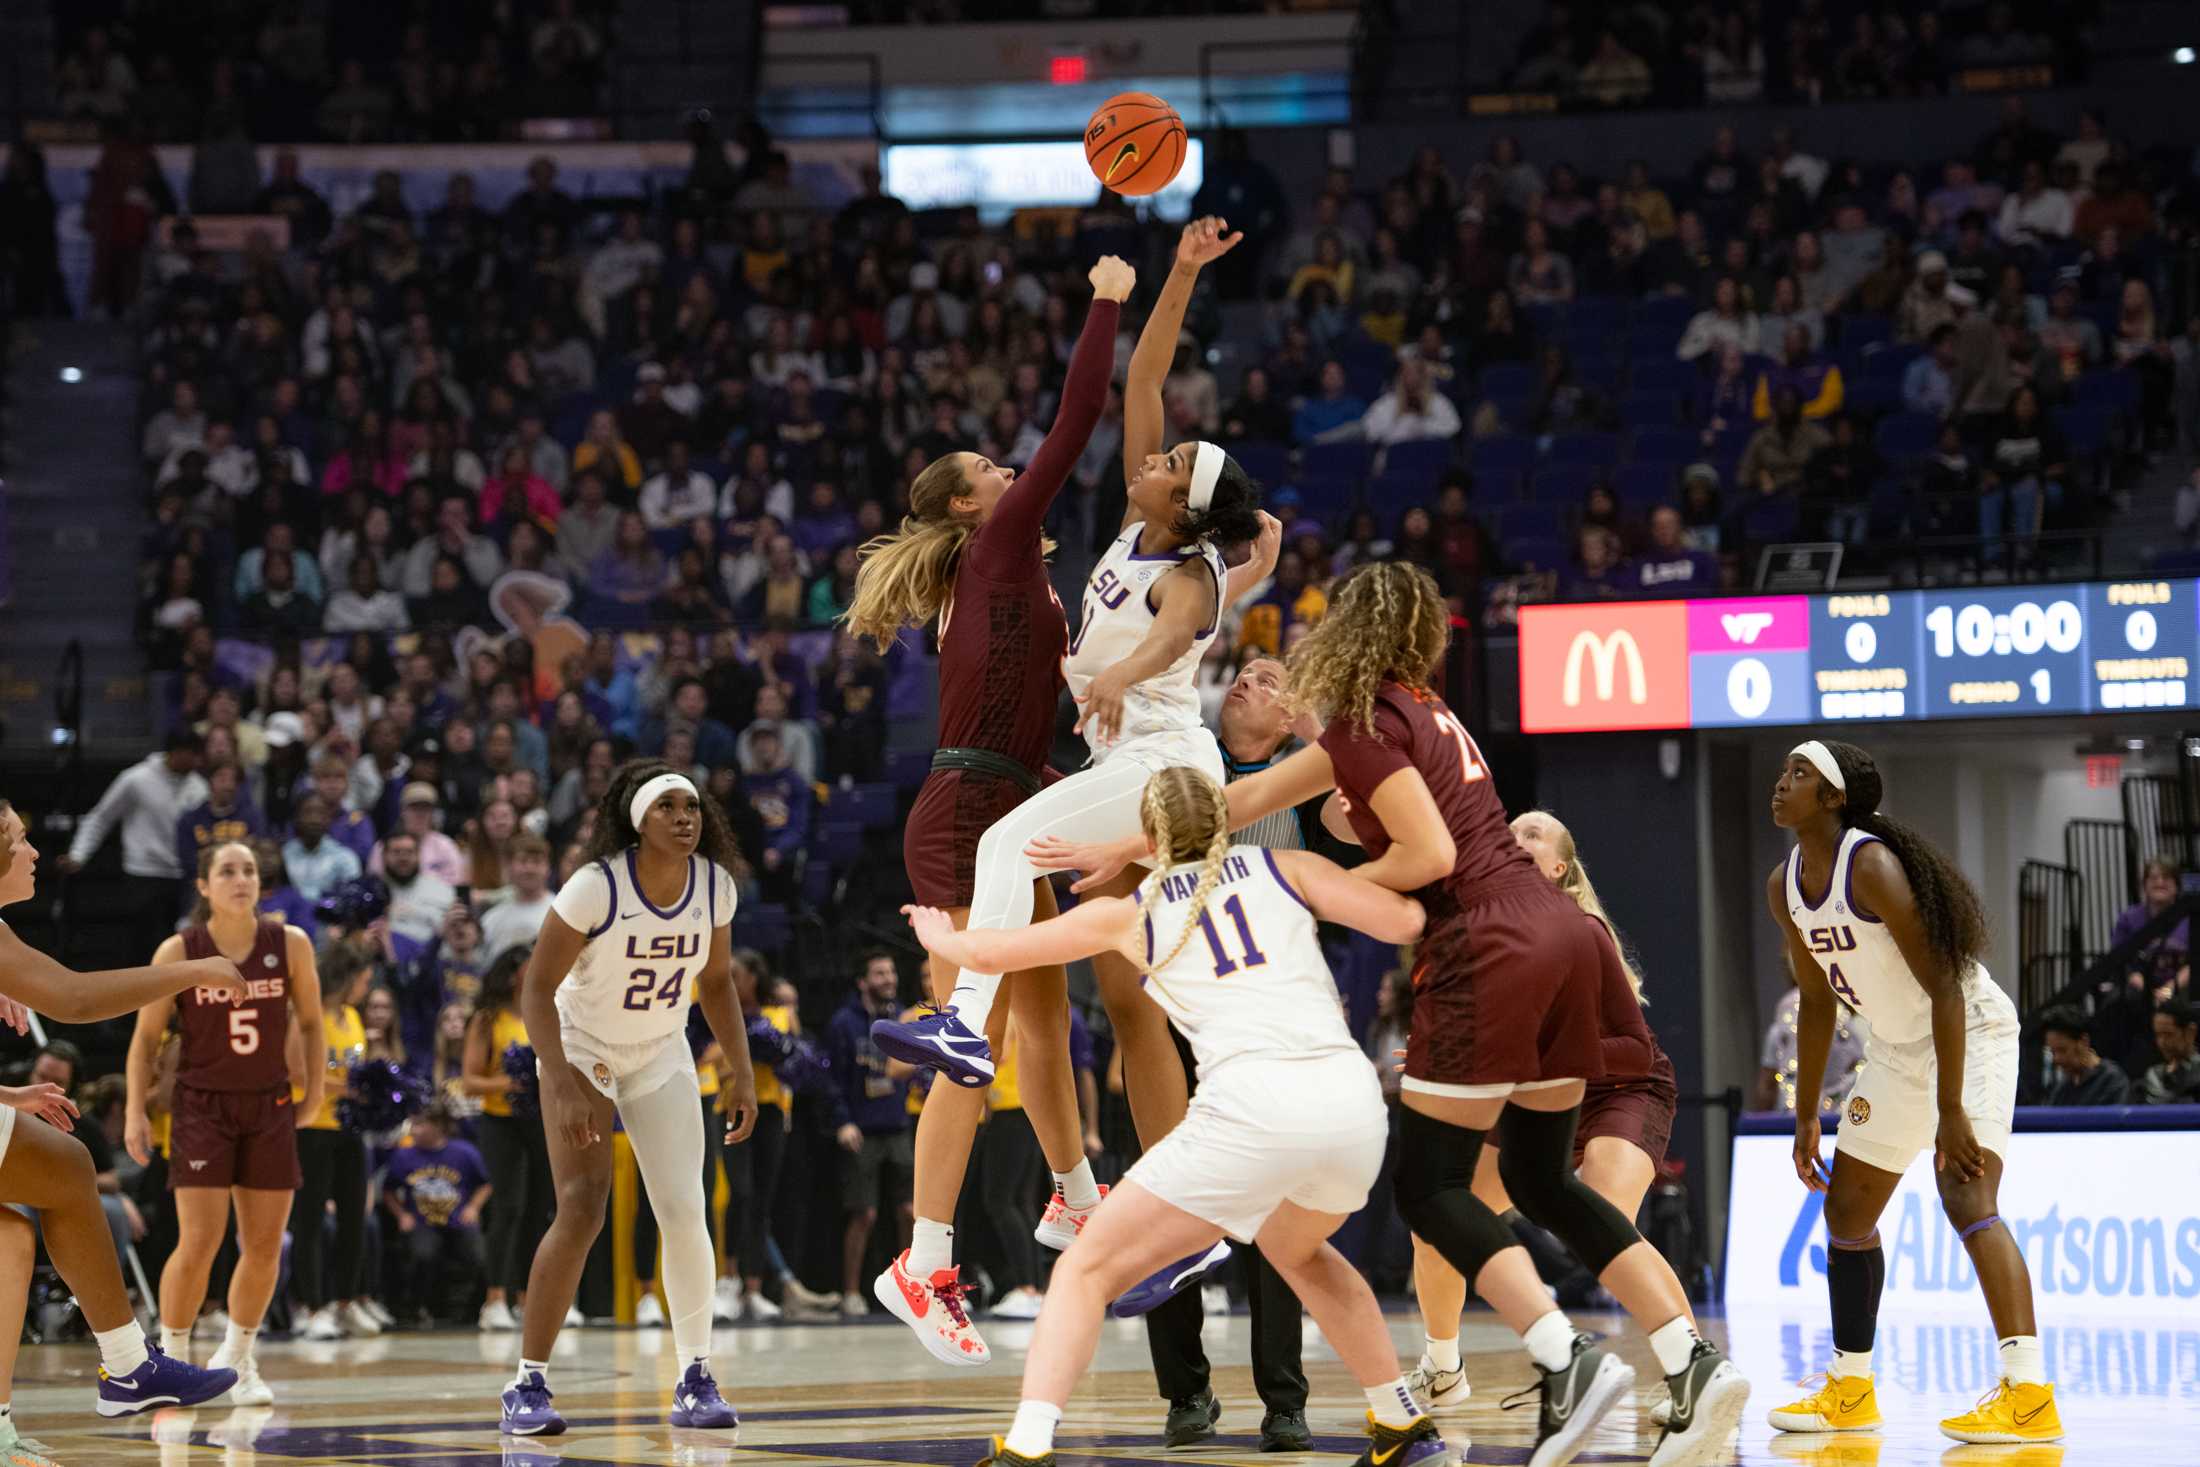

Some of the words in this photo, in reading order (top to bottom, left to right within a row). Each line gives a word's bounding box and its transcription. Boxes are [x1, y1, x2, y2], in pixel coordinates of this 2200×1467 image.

[1089, 568, 1132, 610] SU
[1721, 612, 1774, 643] VT
[1845, 621, 1876, 663] 0
[1926, 600, 2082, 657] 10:00
[2125, 610, 2157, 651] 0
[1727, 657, 1772, 719] 0
[2030, 668, 2051, 705] 1
[1160, 855, 1250, 904] VANITH
[626, 933, 700, 960] LSU
[1196, 893, 1267, 979] 11
[1799, 924, 1858, 954] SU
[194, 977, 285, 1006] HOIES
[623, 967, 687, 1011] 24
[1829, 962, 1862, 1006] 4
[229, 1008, 260, 1056] 5
[1886, 1191, 2200, 1299] Albrtsons
